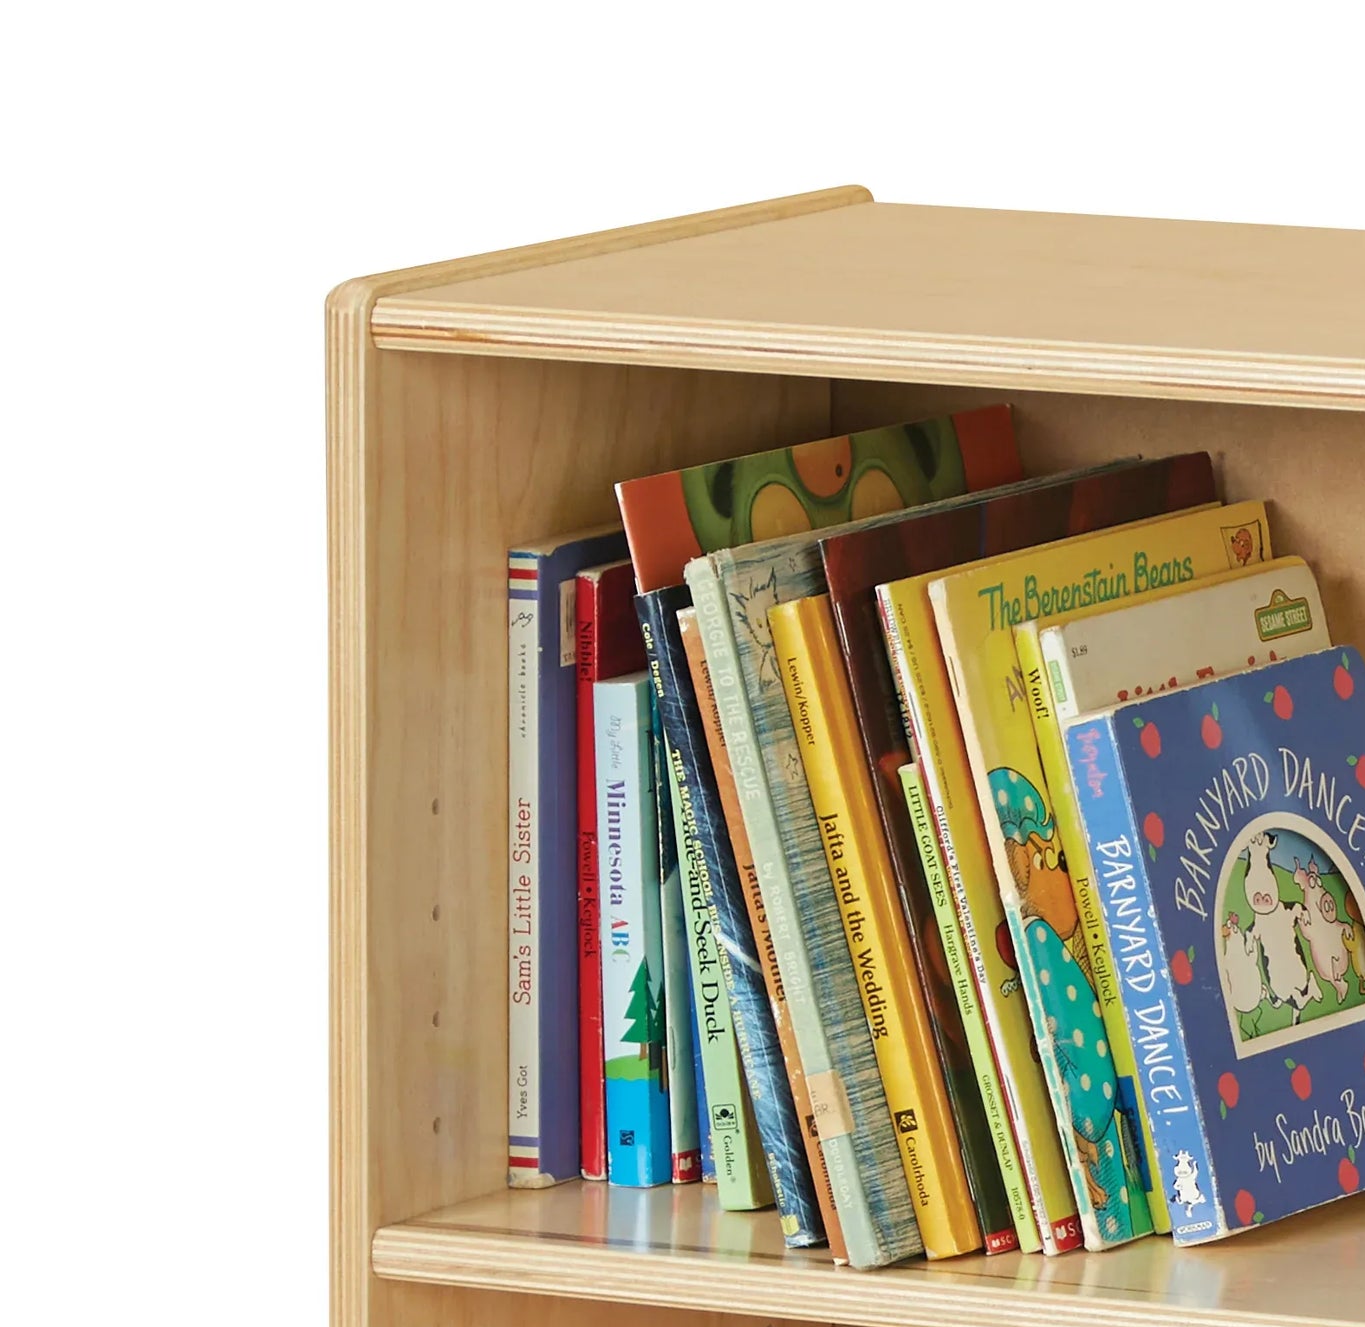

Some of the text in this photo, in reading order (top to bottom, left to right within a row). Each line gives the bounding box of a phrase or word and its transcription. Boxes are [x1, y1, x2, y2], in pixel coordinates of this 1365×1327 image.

[978, 551, 1195, 631] The Berenstain Bears
[1260, 605, 1308, 632] SESAME STREET
[578, 620, 594, 683] Nibble!
[719, 664, 735, 686] TO
[725, 693, 742, 729] THE
[787, 656, 816, 747] Lewin/Kopper
[1026, 667, 1050, 720] Woof!
[671, 748, 686, 783] THE
[731, 730, 762, 800] RESCUE
[678, 783, 699, 836] MAGIC
[1174, 752, 1270, 921] BARNYARD
[606, 778, 631, 964] Minnesota ABC
[693, 839, 714, 902] SCHOOL
[907, 785, 947, 908] LITTLE GOAT SEES
[512, 797, 532, 1006] Sam's Little Sister
[580, 830, 597, 958] Powell Keylock
[708, 903, 723, 936] BUS
[936, 805, 955, 862] Clifford's
[951, 862, 964, 896] First
[959, 896, 982, 962] Valentine's
[819, 813, 889, 1040] Jafta and the Wedding
[1075, 877, 1117, 1007] Powell Keylock
[942, 923, 963, 977] Hargrave
[957, 977, 973, 1016] Hands
[1096, 833, 1188, 1116] BARNYARD DANCE!
[516, 1065, 529, 1120] Yves Got
[722, 1134, 736, 1177] Golden
[905, 1136, 929, 1208] Carolrhoda
[1253, 1131, 1282, 1184] by
[1275, 1109, 1346, 1165] Sandra
